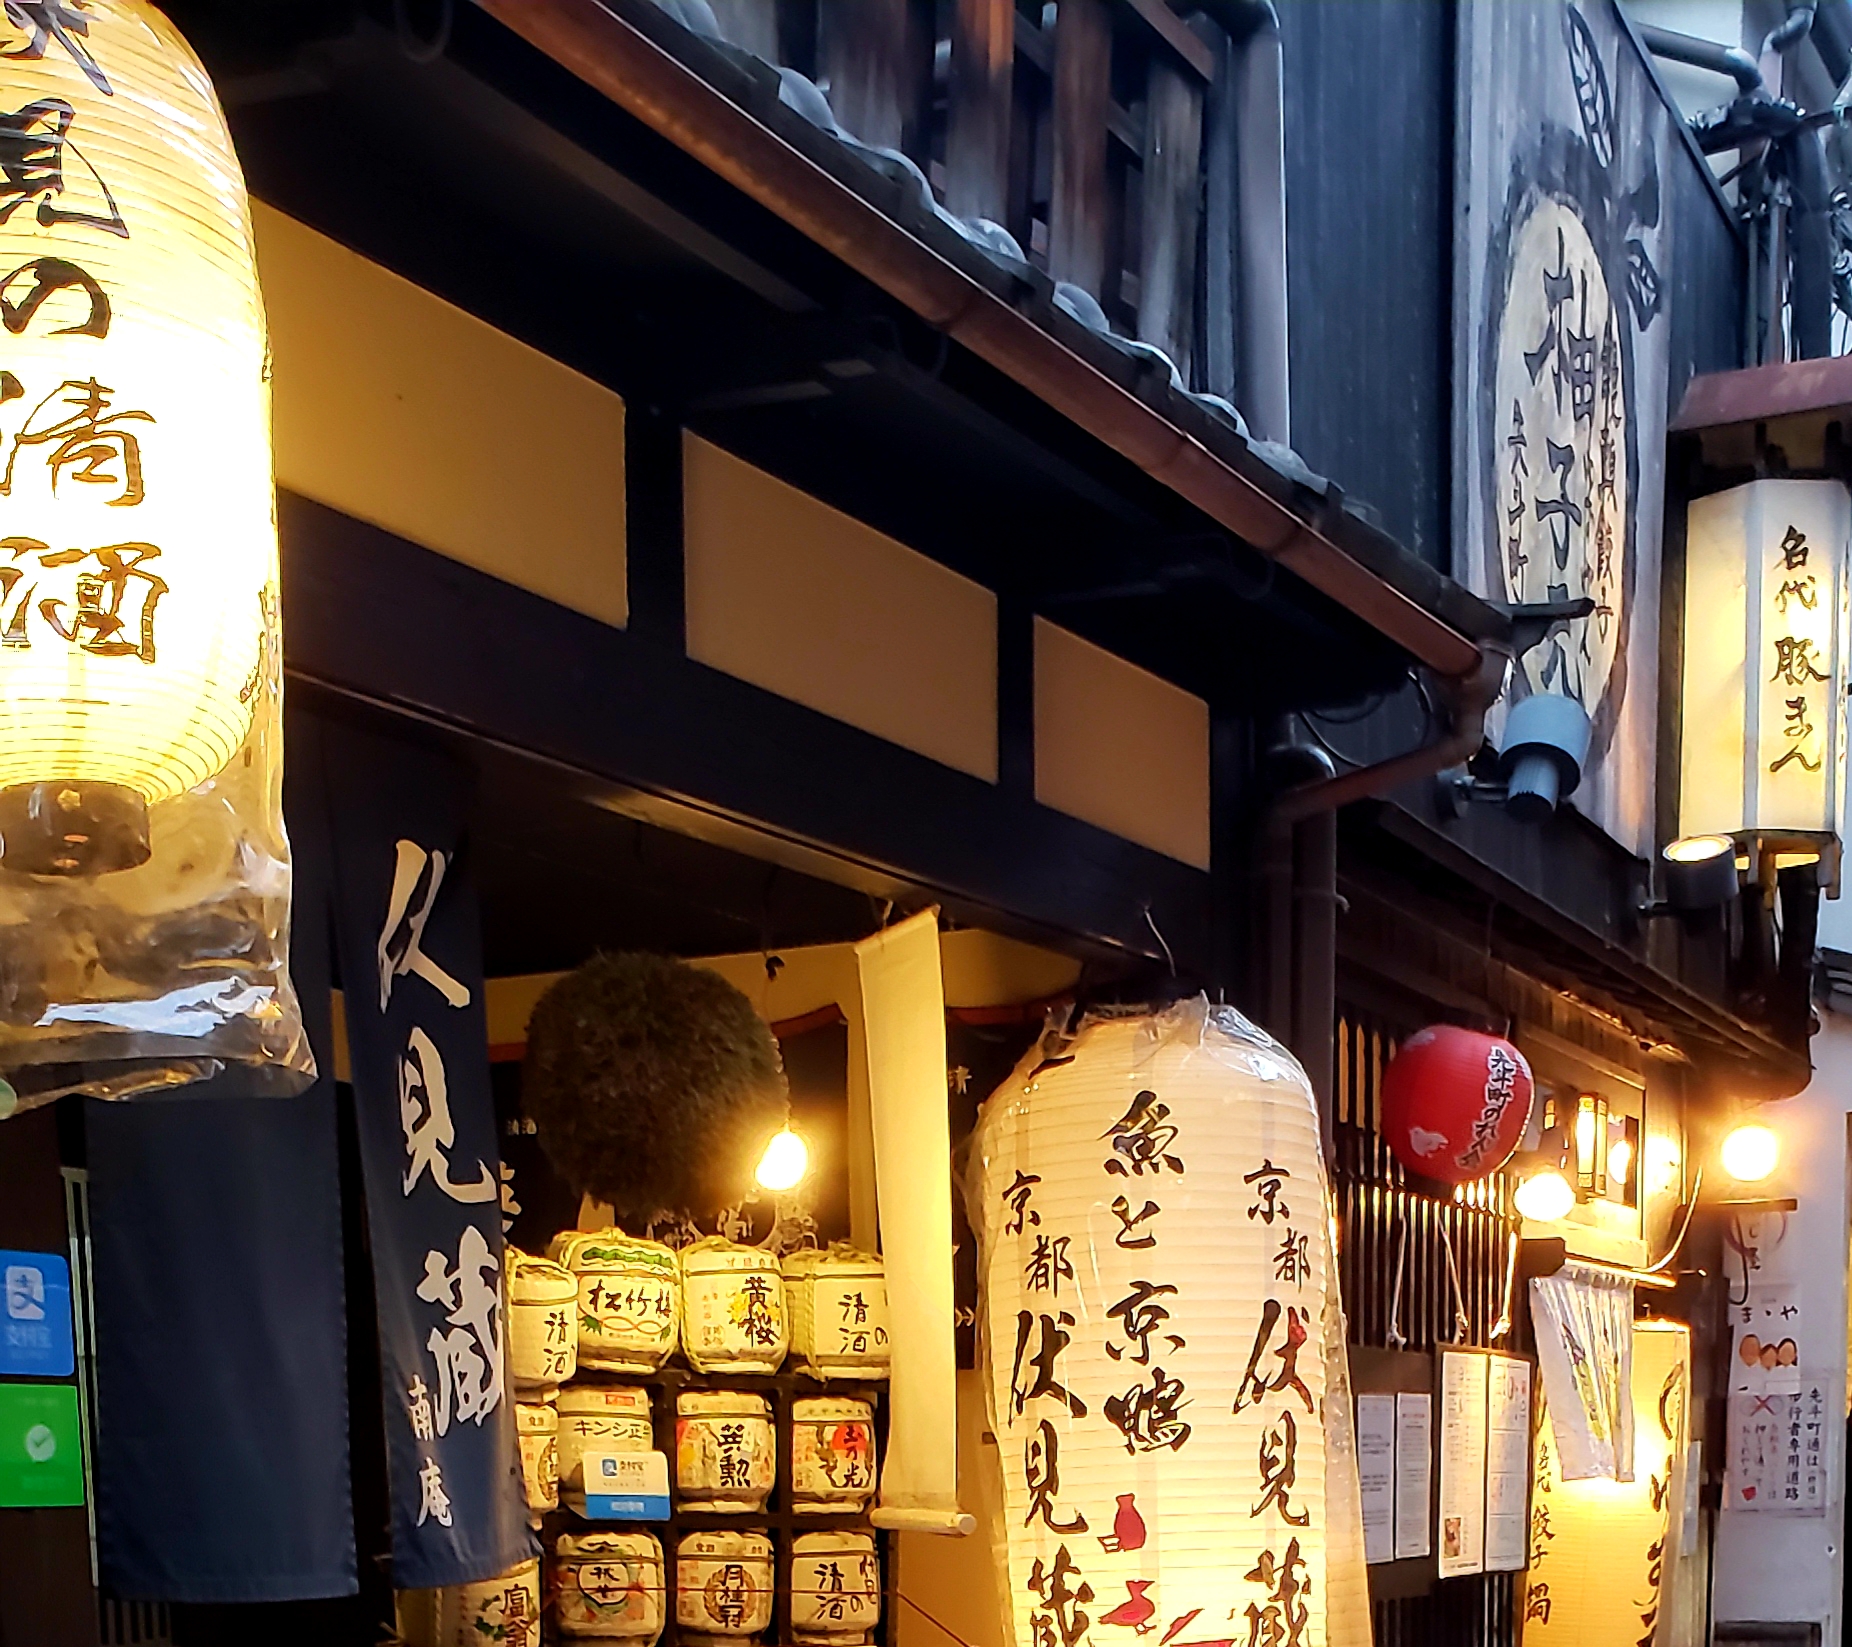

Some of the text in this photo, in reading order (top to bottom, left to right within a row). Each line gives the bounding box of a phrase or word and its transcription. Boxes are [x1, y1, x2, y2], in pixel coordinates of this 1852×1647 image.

[378, 839, 503, 1438] 伏見蔵
[587, 1279, 673, 1319] 松竹梅
[737, 1276, 780, 1347] 黄桜
[837, 1291, 871, 1355] 清酒
[543, 1309, 569, 1377] 清酒
[874, 1326, 889, 1346] の
[719, 1564, 746, 1629] 月桂冠
[814, 1561, 847, 1620] 清酒
